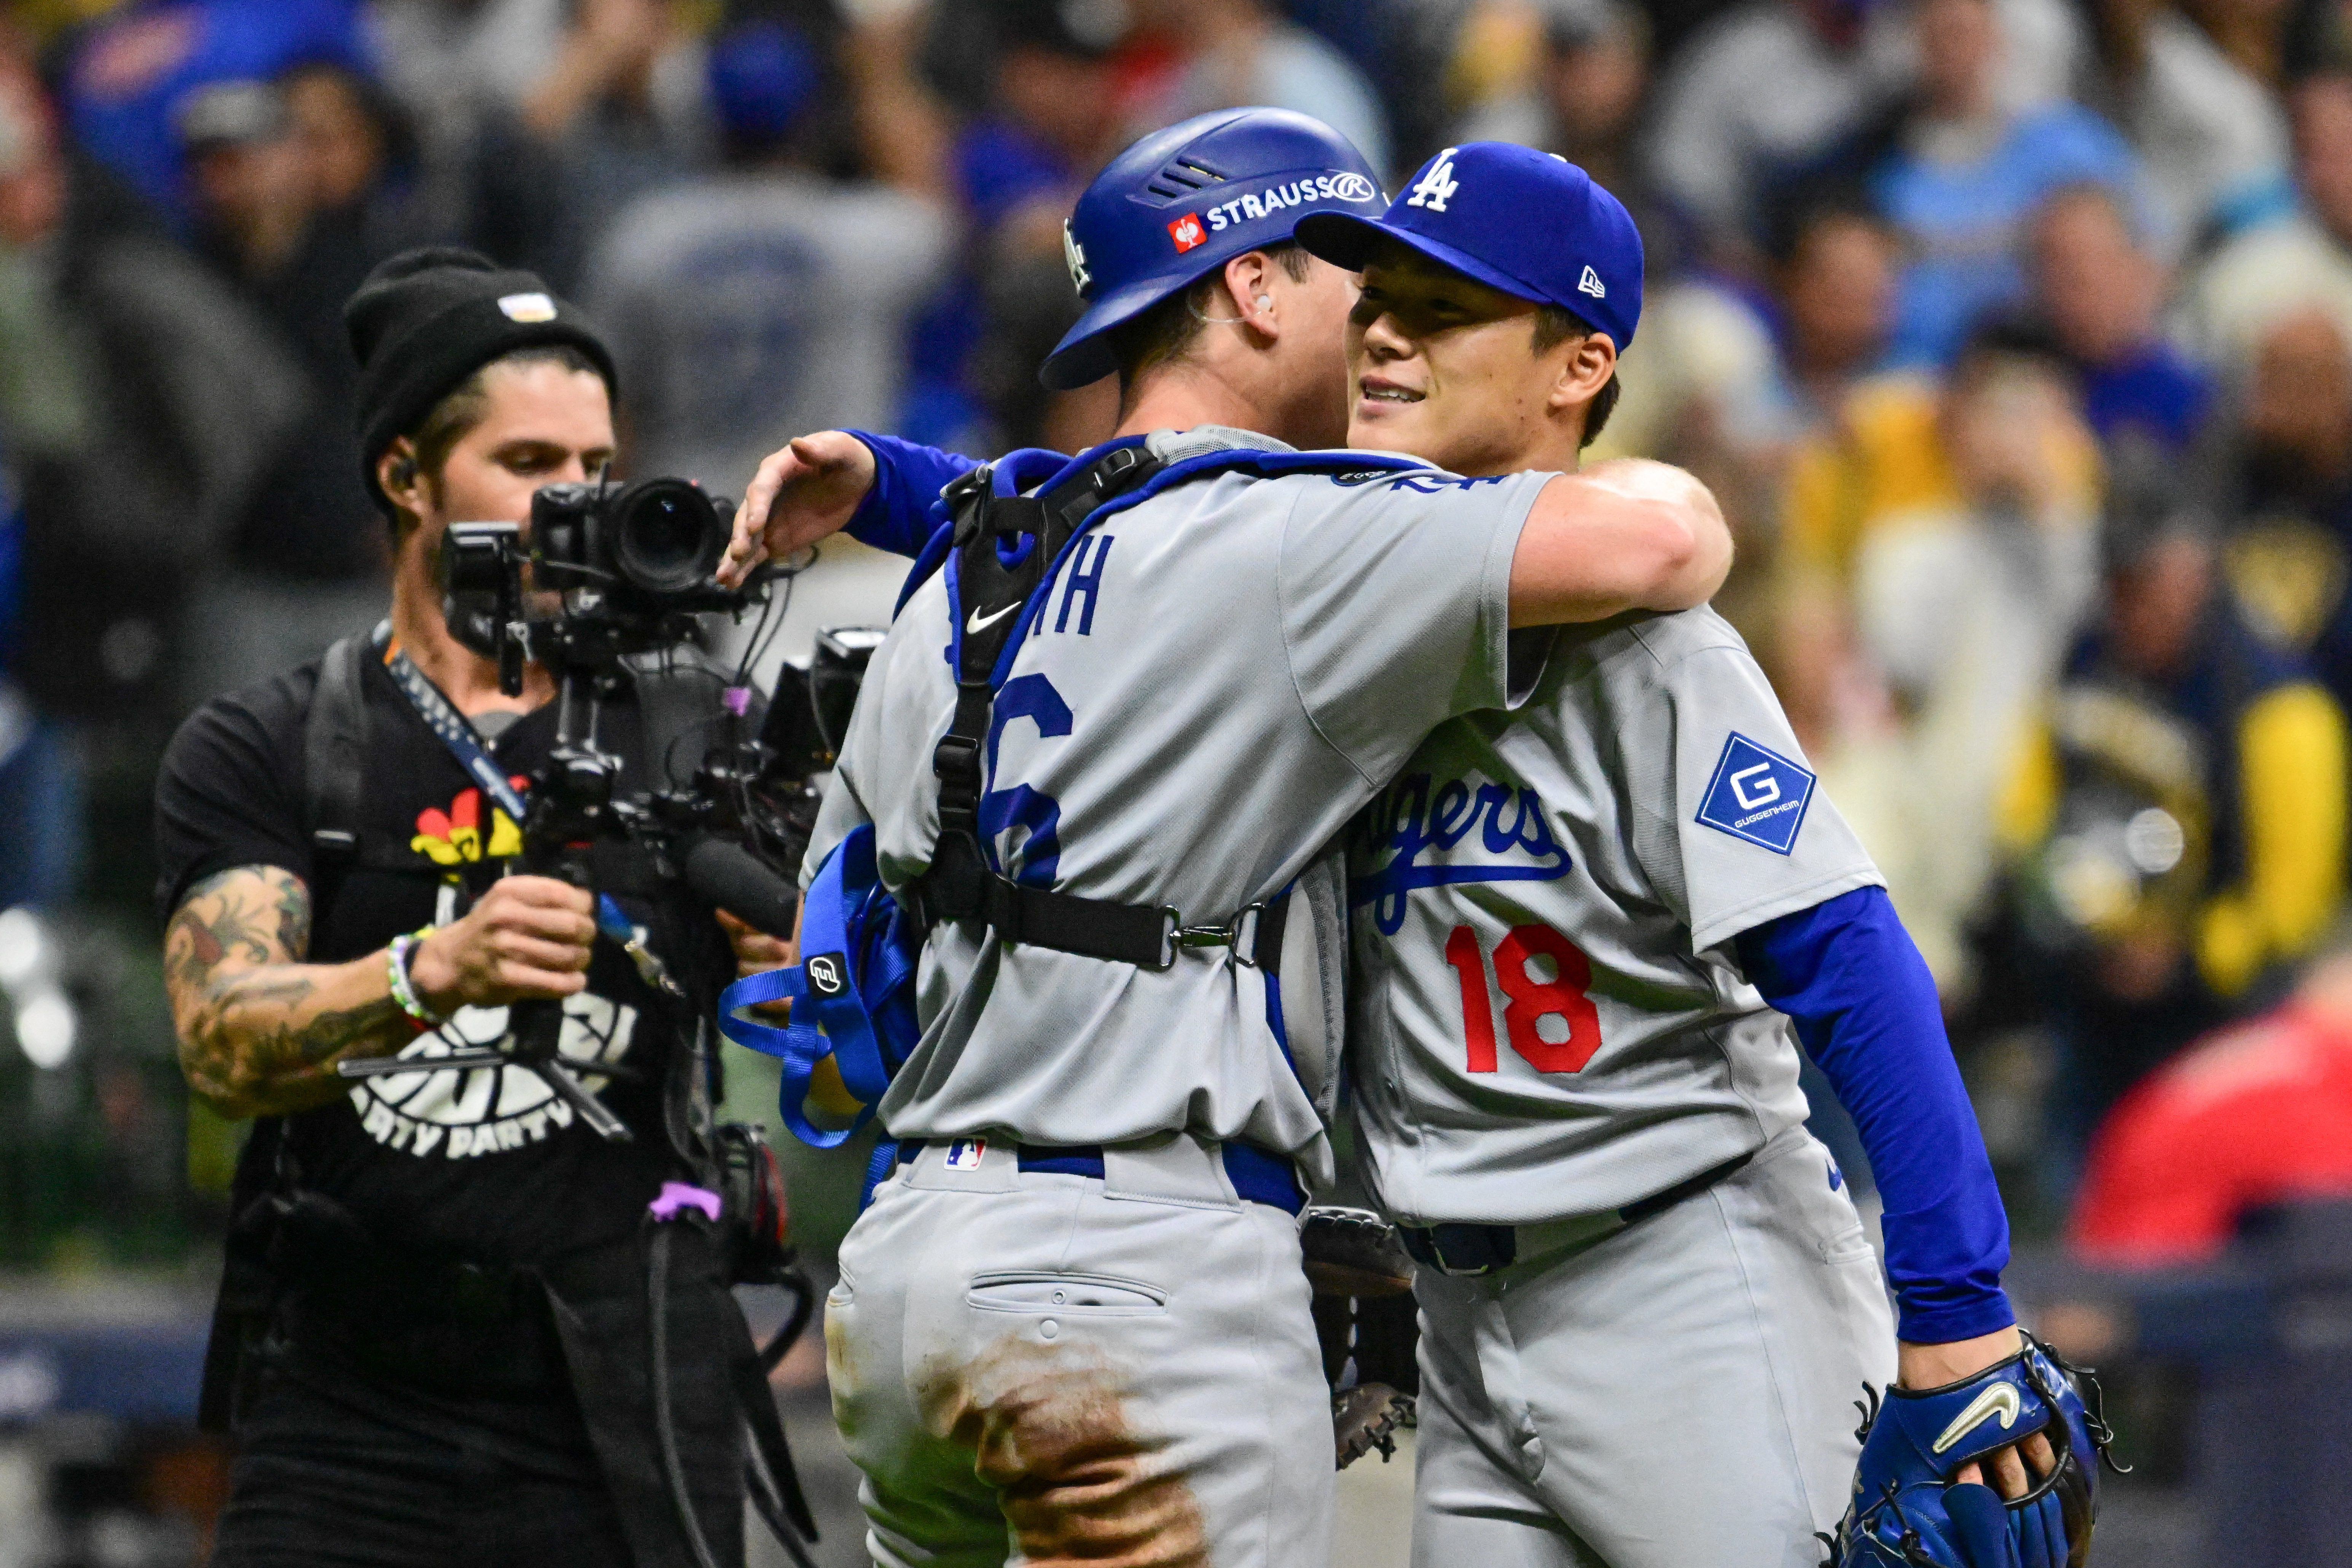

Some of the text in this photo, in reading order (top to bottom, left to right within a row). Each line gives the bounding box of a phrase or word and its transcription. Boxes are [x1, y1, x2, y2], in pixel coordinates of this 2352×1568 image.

[1207, 176, 1334, 231] STRAUSS
[1407, 148, 1459, 212] LA
[977, 672, 1073, 890] 6
[1730, 762, 1780, 810] G
[1734, 801, 1800, 828] GUGGENHEIM
[1444, 923, 1602, 1073] 18
[446, 1098, 573, 1159] PARTY
